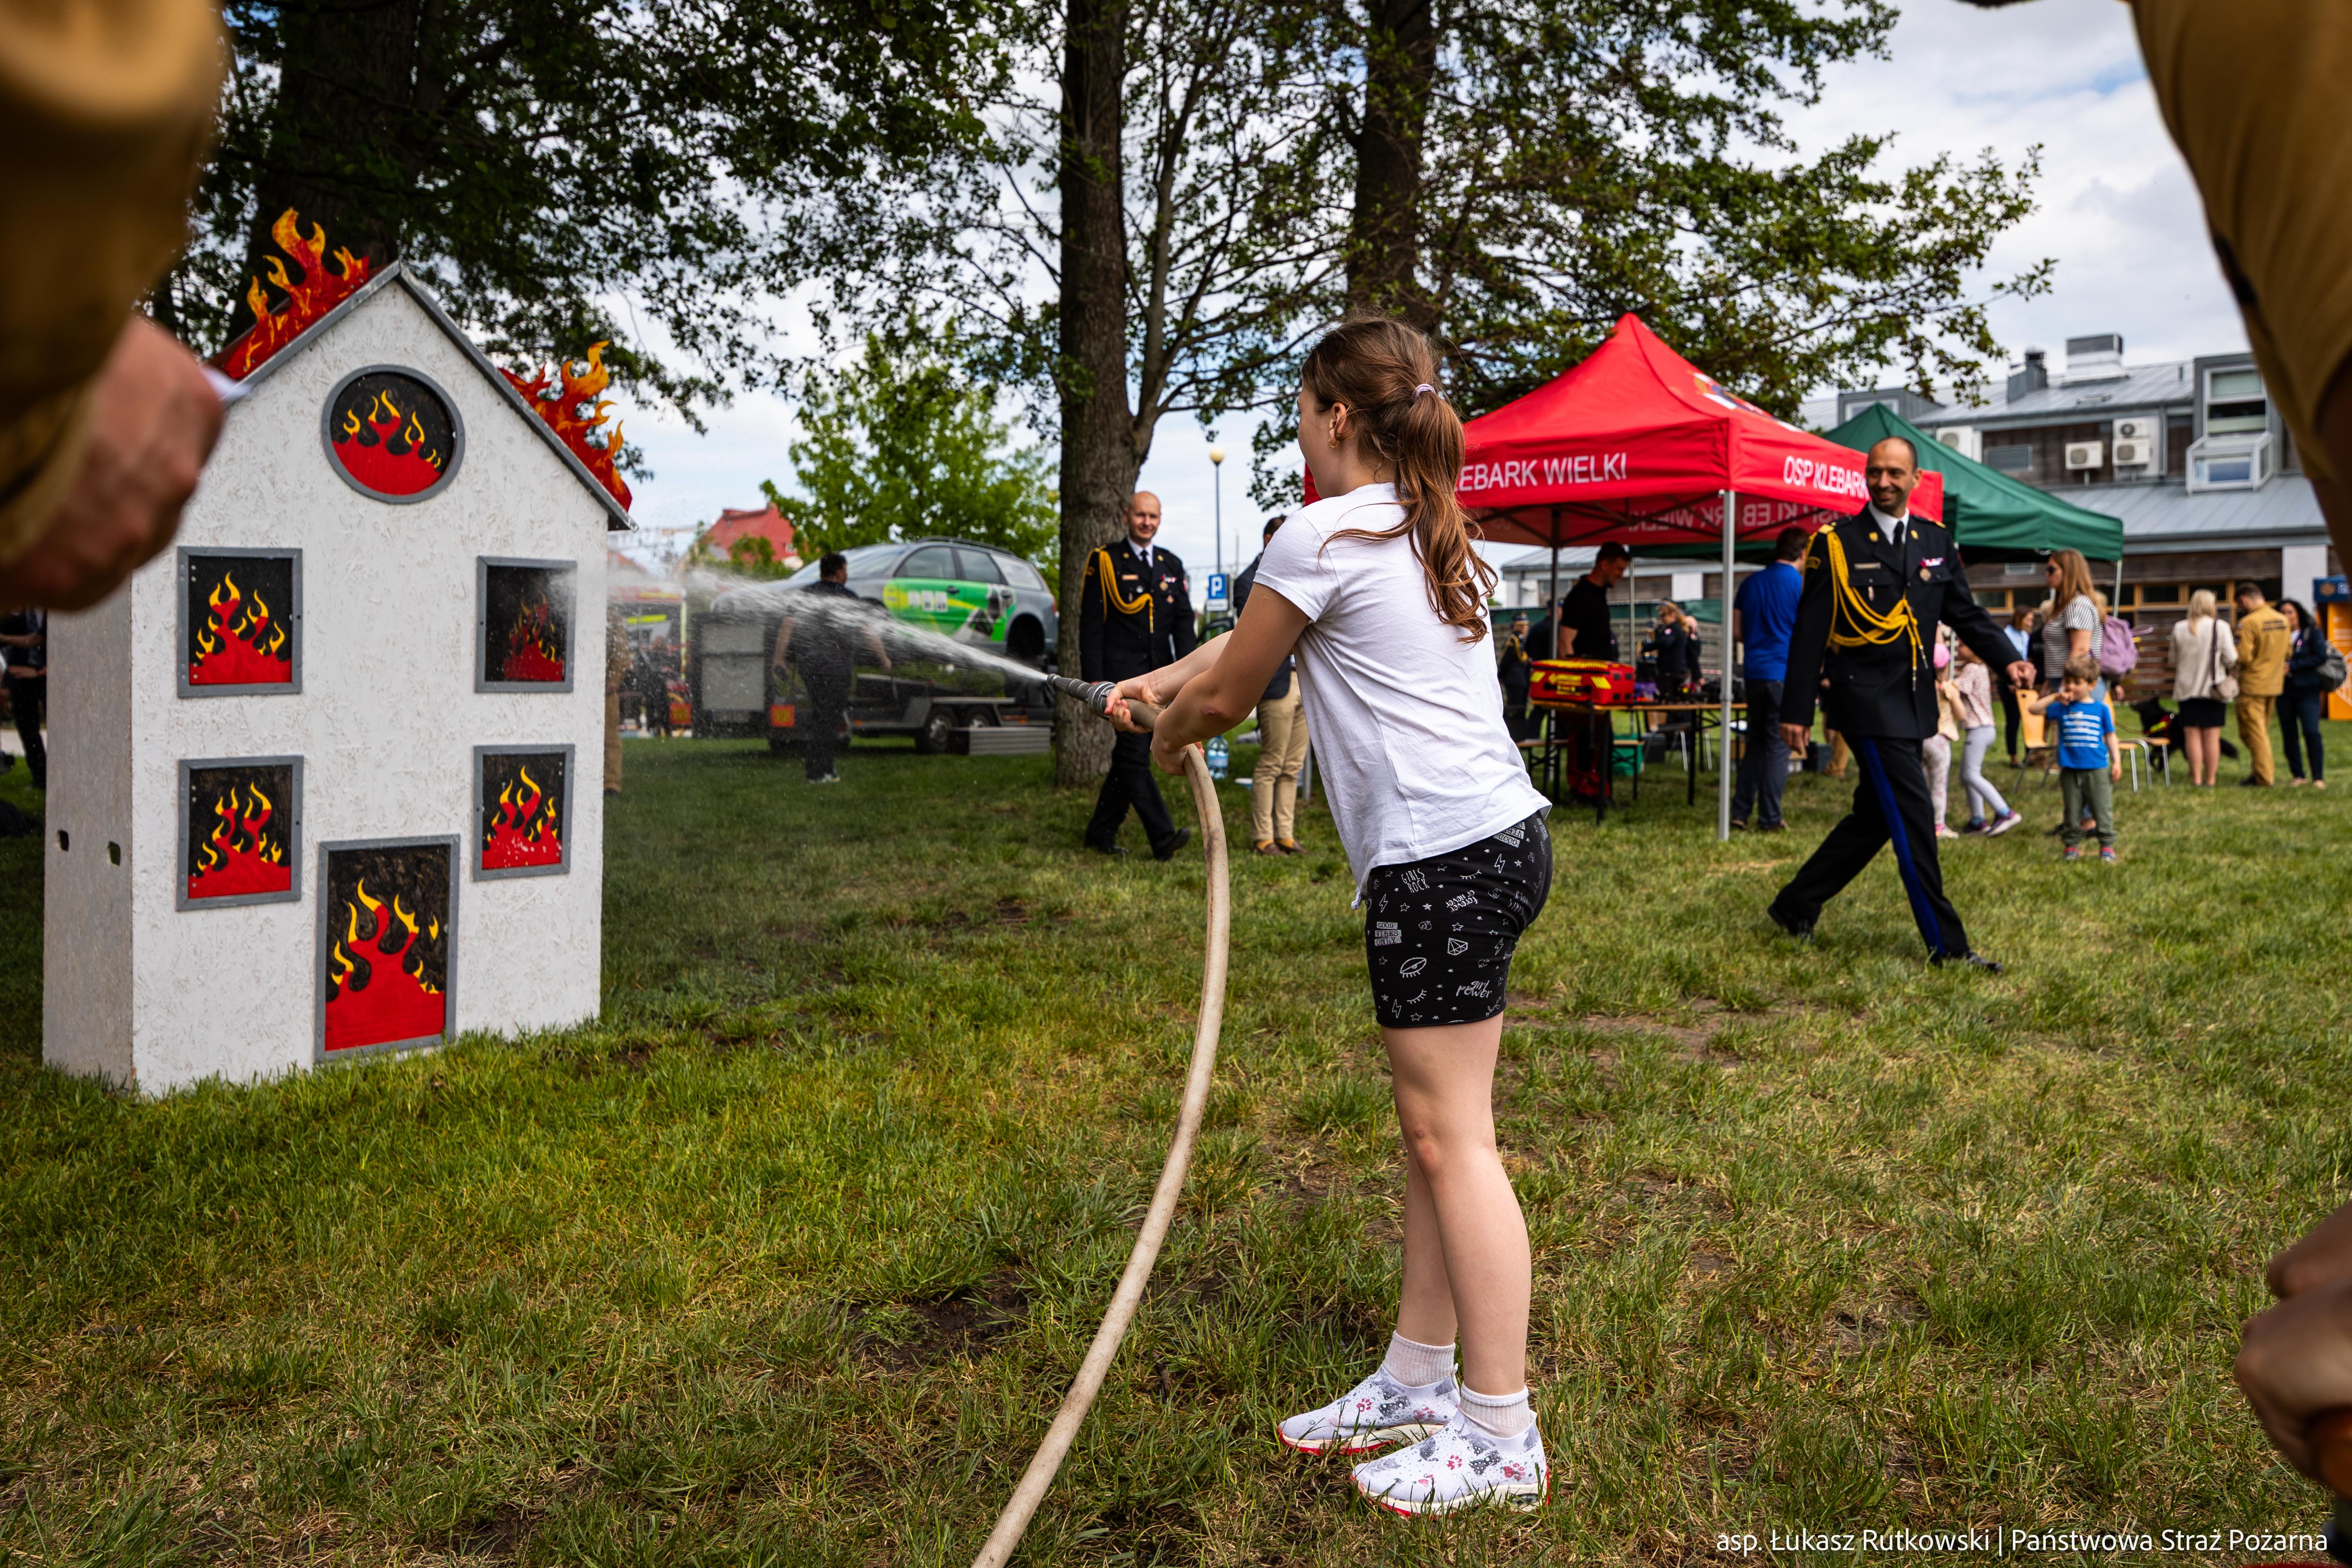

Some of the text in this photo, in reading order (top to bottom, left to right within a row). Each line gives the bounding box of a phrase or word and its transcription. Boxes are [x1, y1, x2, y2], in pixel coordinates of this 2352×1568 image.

[1454, 452, 1627, 492] EBARK WIELKI
[1783, 455, 1813, 487] OSP
[1211, 576, 1222, 597] P
[1401, 868, 1425, 884] GIRLS
[1407, 878, 1430, 893] ROCK
[1445, 894, 1466, 908] never
[1449, 896, 1478, 913] forever
[1375, 937, 1396, 946] ONLY
[1456, 985, 1492, 998] power
[1471, 980, 1490, 991] girl
